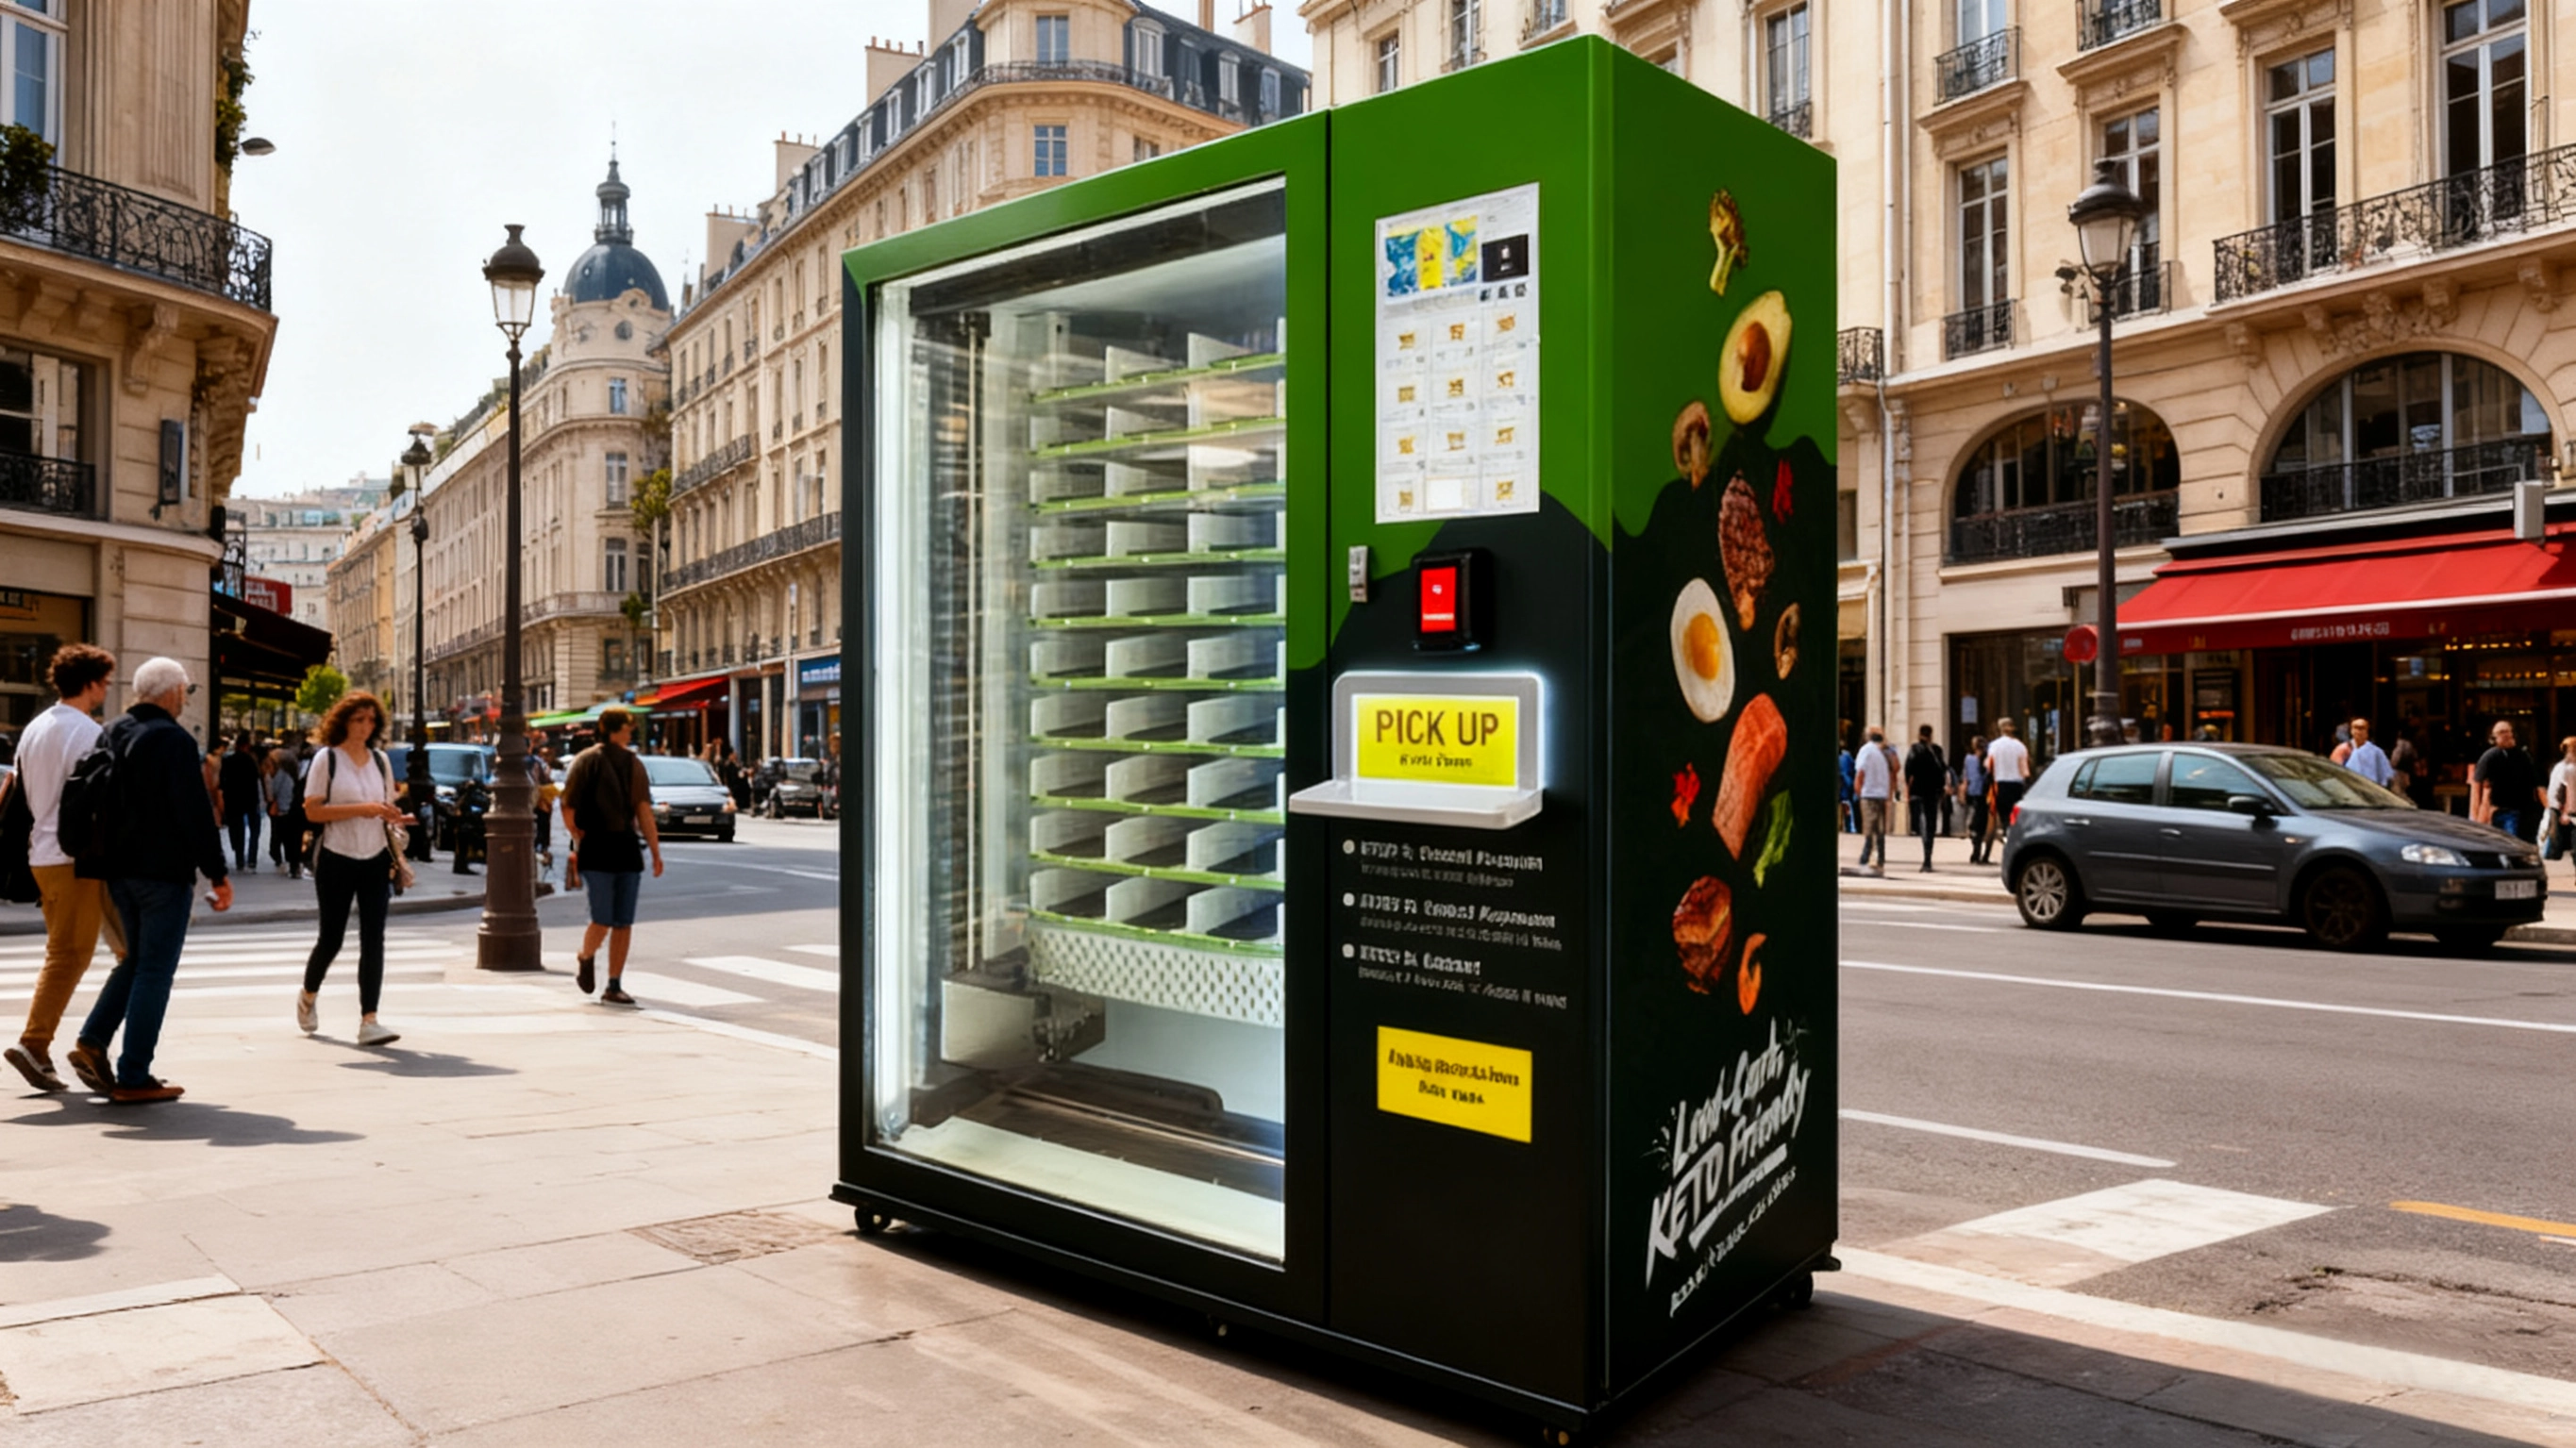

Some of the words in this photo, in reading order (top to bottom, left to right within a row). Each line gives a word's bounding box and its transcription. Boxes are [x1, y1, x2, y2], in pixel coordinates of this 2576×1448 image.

[1376, 708, 1446, 746] PICK
[1458, 711, 1499, 746] UP
[1646, 1141, 1725, 1291] KETO
